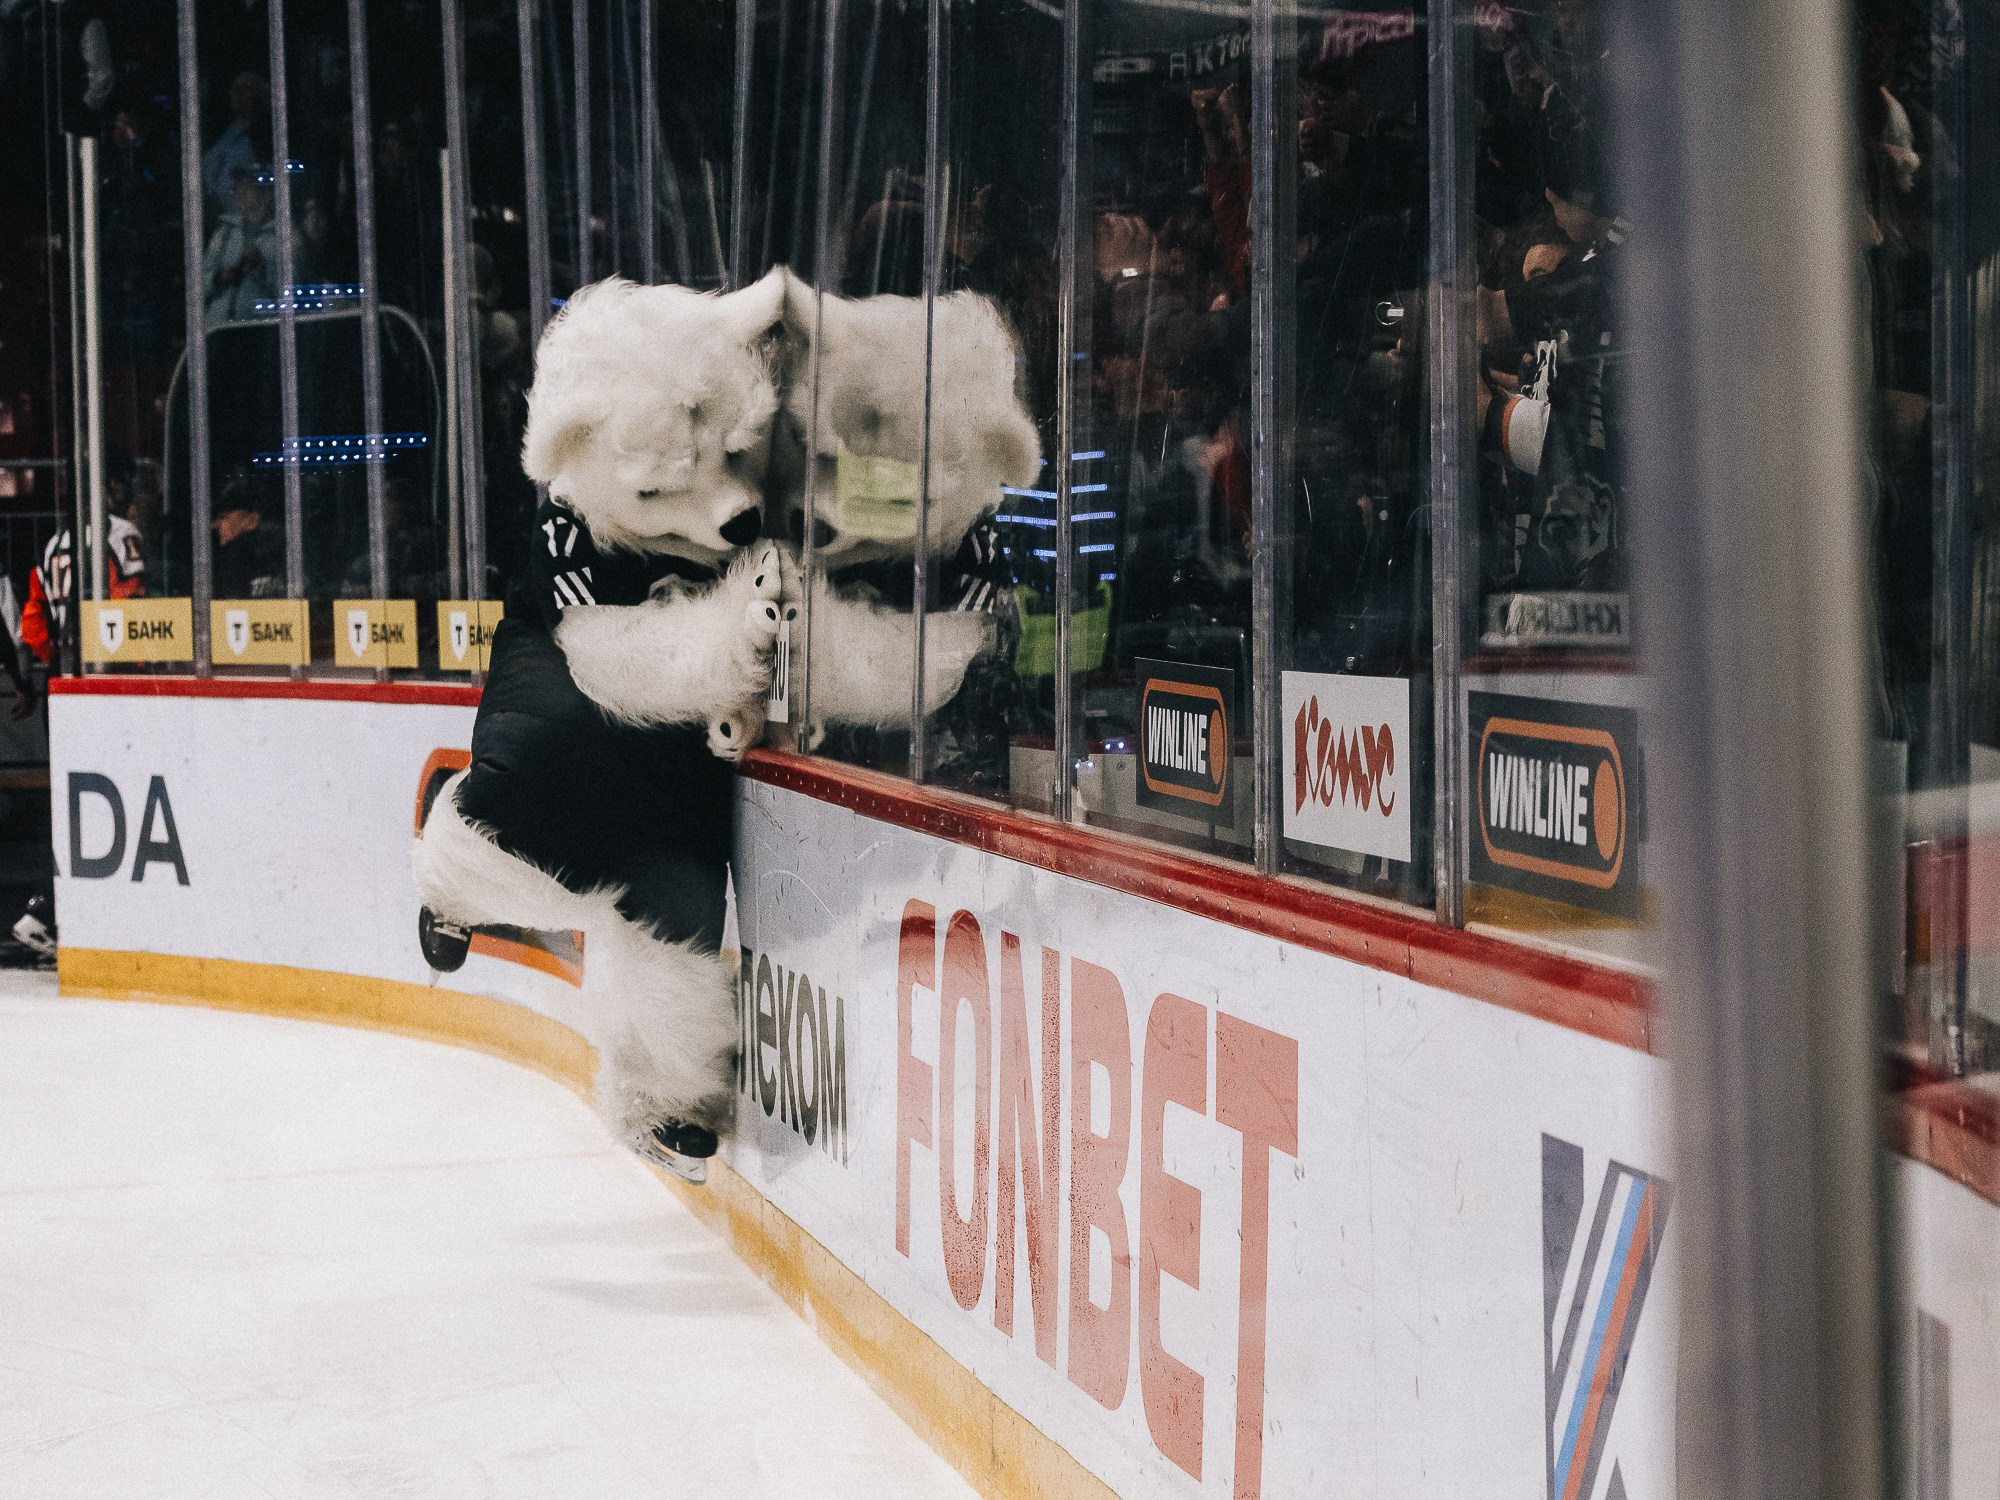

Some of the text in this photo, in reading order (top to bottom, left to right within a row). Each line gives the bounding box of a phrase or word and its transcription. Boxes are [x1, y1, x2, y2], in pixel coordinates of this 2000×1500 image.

[541, 516, 579, 559] 17
[127, 619, 175, 640] БАНК
[251, 621, 294, 642] БАНК
[371, 622, 406, 644] БАНК
[1149, 705, 1207, 775] WINLINE
[1489, 752, 1589, 847] WINLINE
[52, 771, 191, 887] DA
[895, 897, 1299, 1500] FONBET
